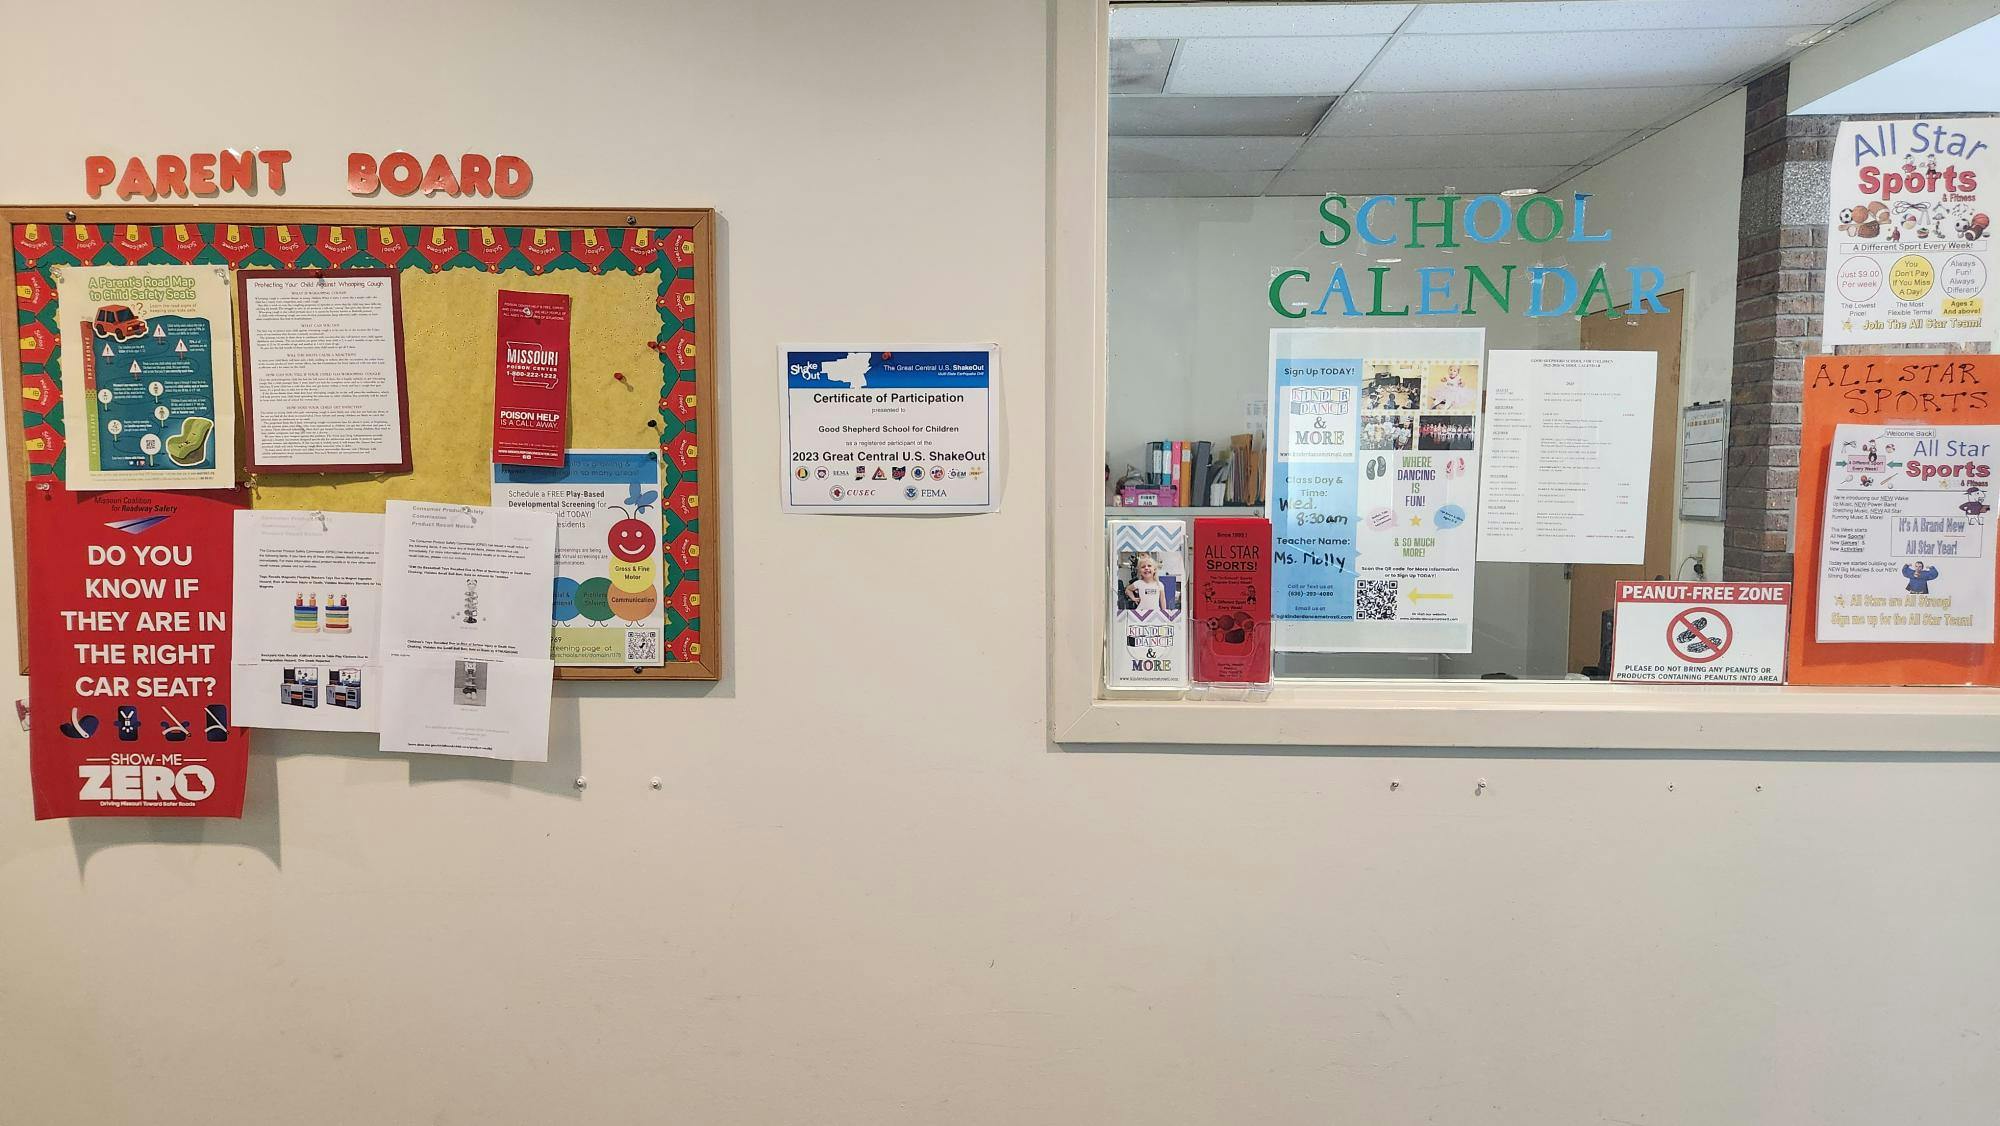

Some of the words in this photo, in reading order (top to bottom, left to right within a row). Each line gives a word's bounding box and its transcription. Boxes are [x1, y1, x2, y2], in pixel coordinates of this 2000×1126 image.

[1854, 122, 1896, 167] All
[1909, 122, 1988, 160] Star
[85, 150, 293, 198] PARENT
[347, 152, 534, 198] BOARD
[1857, 165, 1978, 201] Sports
[1949, 193, 1976, 201] Fitness
[1319, 193, 1612, 248] SCHOOL
[1852, 243, 1859, 251] A
[1861, 243, 1897, 251] Different
[1899, 242, 1921, 251] Sport
[1923, 242, 1947, 251] Every
[1949, 241, 1974, 250] Week!
[1904, 260, 1918, 268] You
[1895, 269, 1913, 277] Don't
[1915, 270, 1929, 279] Pay
[89, 277, 99, 289] A
[100, 276, 142, 289] Parent's
[144, 276, 171, 288] Road
[171, 276, 195, 291] Map
[254, 281, 283, 289] Protecting
[316, 281, 336, 289] Against
[90, 291, 101, 301] to
[103, 289, 129, 301] Child
[131, 289, 164, 302] Safety
[166, 289, 196, 300] Seats
[1268, 265, 1670, 318] CALENDAR
[507, 348, 559, 367] MISSOURI
[790, 361, 818, 375] Shake
[1284, 367, 1304, 376] Sign
[1306, 368, 1319, 376] Up
[1321, 367, 1355, 375] TODAY!
[506, 371, 557, 379] 1-800-222-1222
[802, 370, 821, 380] Out
[1812, 363, 1883, 388] ALL
[1898, 362, 1980, 385] STAR
[813, 392, 874, 404] Certificate
[876, 392, 888, 403] of
[890, 392, 964, 406] Participation
[1843, 388, 1988, 415] SPORTS
[500, 411, 535, 420] POISON
[536, 413, 560, 422] HELP
[818, 425, 841, 433] Good
[842, 425, 880, 435] Shepherd
[882, 425, 910, 433] School
[912, 425, 923, 433] for
[925, 425, 959, 433] Children
[1295, 431, 1345, 445] MORE
[1913, 439, 1939, 457] All
[1945, 440, 1990, 457] Star
[792, 451, 819, 462] 2023
[822, 451, 854, 462] Great
[857, 451, 899, 462] Central
[902, 451, 926, 462] U.S.
[929, 451, 986, 462] ShakeOut
[1402, 456, 1432, 468] WHERE
[1397, 469, 1436, 481] DANCING
[1905, 460, 1991, 481] Sports
[921, 489, 947, 497] FEMA
[1411, 482, 1420, 493] IS
[508, 490, 540, 499] Schedule
[547, 490, 565, 498] FREE
[566, 490, 605, 499] Play-Based
[1405, 495, 1426, 507] FUN!
[121, 505, 153, 514] Roadway
[154, 504, 177, 513] Safety
[508, 500, 560, 510] Developmental
[561, 500, 595, 510] Screening
[1898, 518, 1911, 533] It's
[1912, 518, 1919, 533] A
[1920, 518, 1944, 533] Brand
[1945, 518, 1965, 533] New
[1277, 537, 1316, 545] Teacher
[1318, 537, 1350, 545] Name:
[1402, 537, 1412, 547] SO
[1413, 537, 1435, 547] MUCH
[1205, 545, 1226, 559] ALL
[1229, 545, 1259, 559] STAR
[1402, 547, 1425, 557] MORE!
[1906, 540, 1917, 555] All
[1918, 540, 1936, 555] Star
[1936, 540, 1957, 556] Year!
[88, 545, 126, 566] DO
[132, 545, 193, 566] YOU
[1274, 551, 1297, 565] Ms.
[1206, 560, 1258, 570] SPORTS!
[85, 578, 167, 599] KNOW
[175, 578, 199, 599] IF
[1622, 585, 1734, 600] PEANUT-FREE
[1738, 587, 1783, 601] ZONE
[60, 611, 130, 632] THEY
[135, 611, 190, 632] ARE
[198, 611, 226, 632] IN
[74, 644, 126, 664] THE
[133, 644, 215, 665] RIGHT
[1146, 648, 1157, 658] &
[1132, 659, 1171, 672] MORE
[1625, 664, 1652, 672] PLEASE
[1616, 672, 1656, 680] PRODUCTS
[75, 676, 130, 697] CAR
[136, 676, 217, 698] SEAT?
[111, 753, 183, 766] SHOW-ME
[78, 764, 216, 801] ZERO
